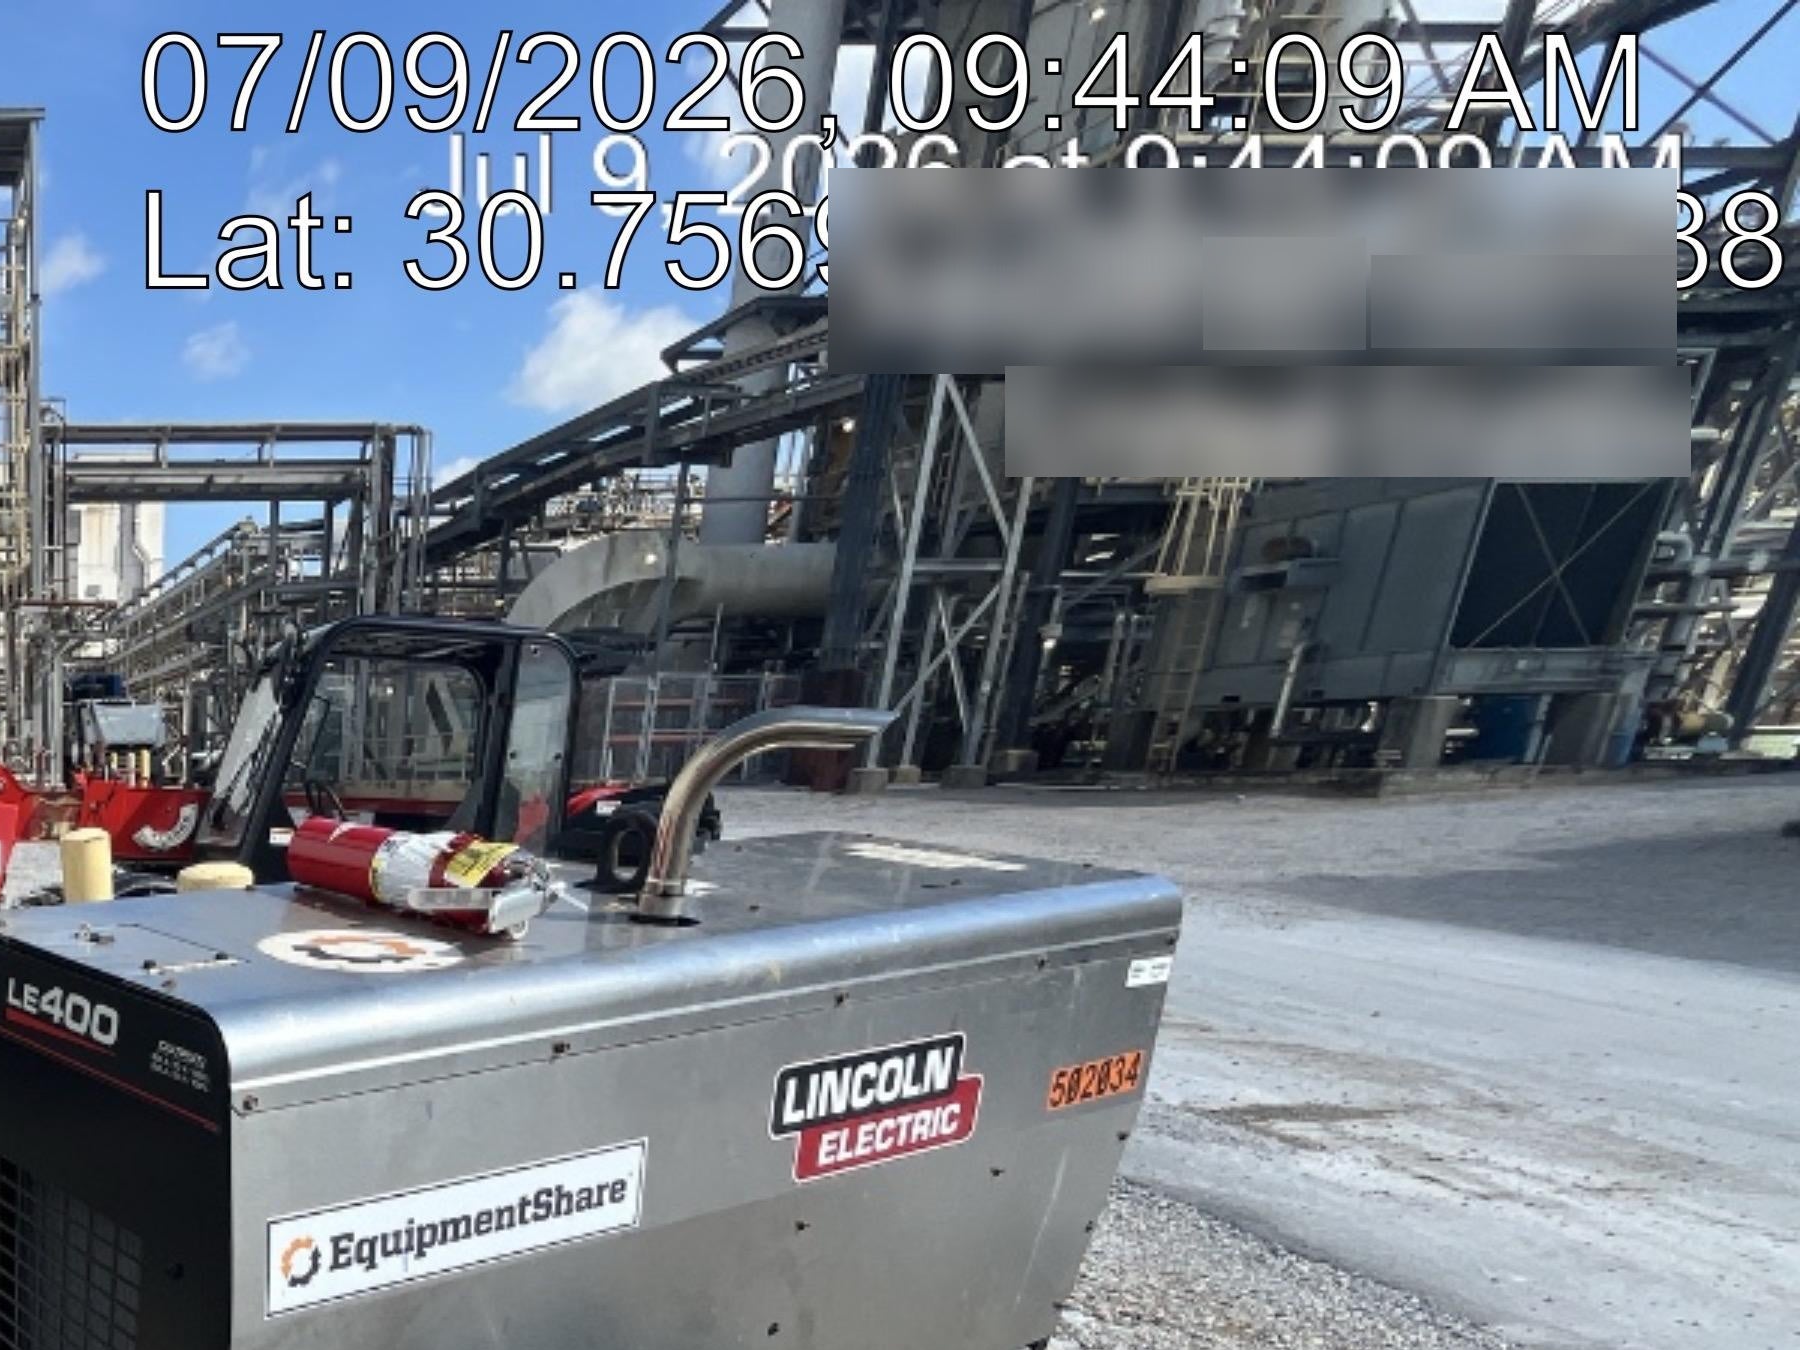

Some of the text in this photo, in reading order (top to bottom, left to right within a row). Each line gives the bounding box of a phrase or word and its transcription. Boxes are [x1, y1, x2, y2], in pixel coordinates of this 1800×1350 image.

[6, 976, 120, 1047] LE400
[782, 1046, 956, 1124] LINCOLN
[1049, 1051, 1142, 1108] 502034
[816, 1102, 962, 1167] ELECTRIC
[328, 1176, 628, 1273] EquipmentShare
